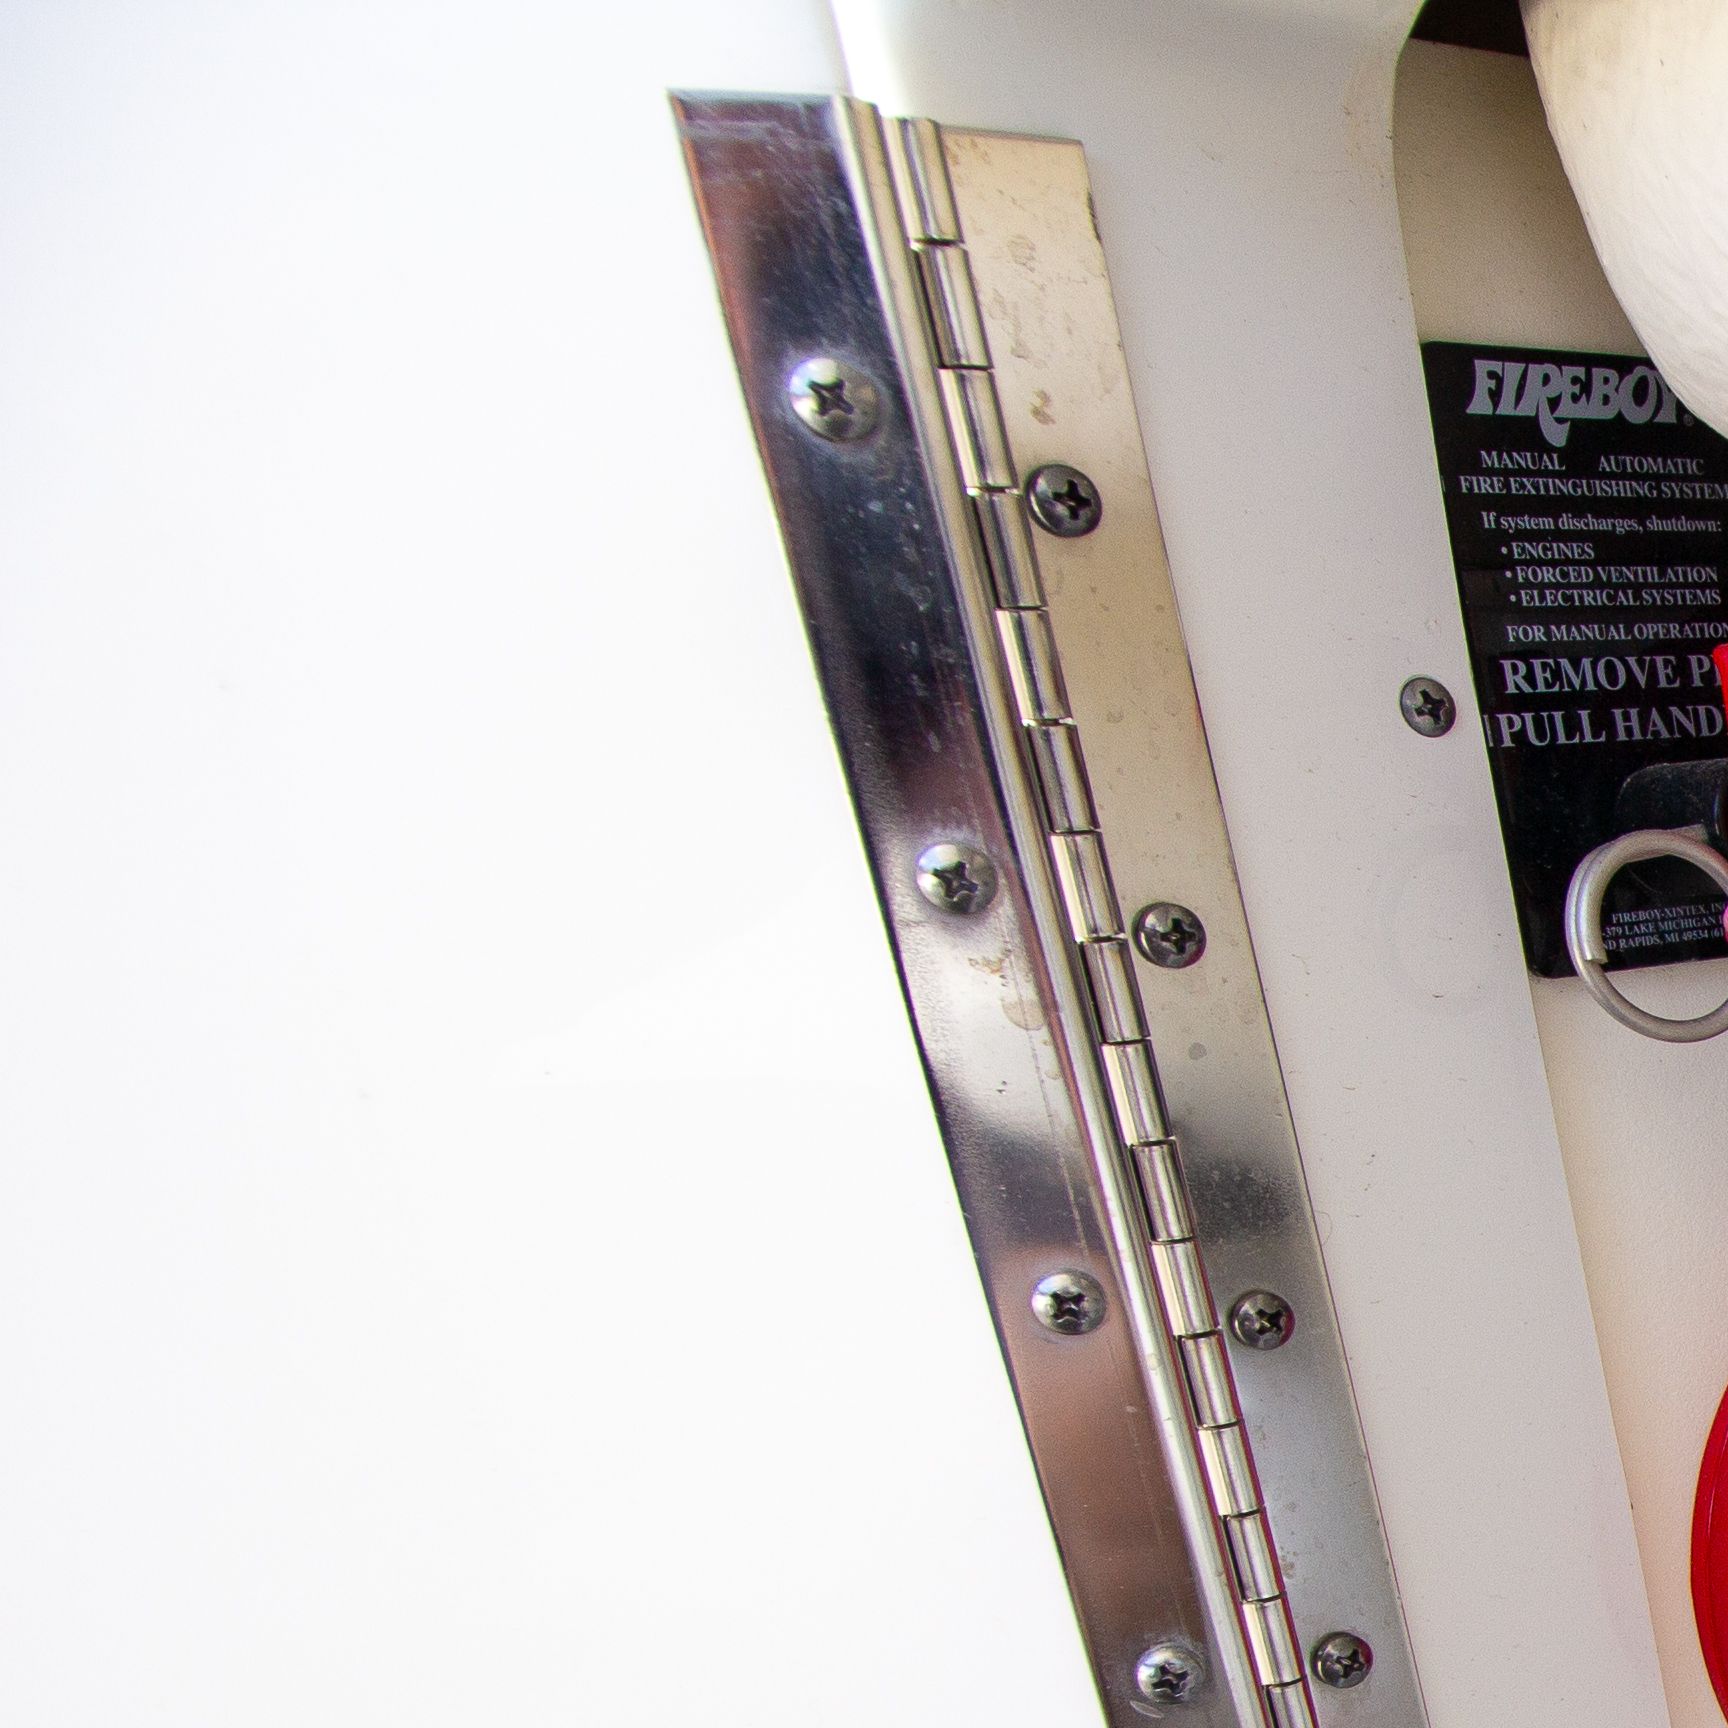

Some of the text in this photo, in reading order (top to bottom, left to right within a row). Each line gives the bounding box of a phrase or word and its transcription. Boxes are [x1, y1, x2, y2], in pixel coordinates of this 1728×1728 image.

[1466, 360, 1682, 447] FIREBOY
[1481, 451, 1704, 475] MANUAL AUTOMATIC
[1461, 475, 1506, 494] FIRE
[1512, 478, 1657, 499] EXTINGUISHING
[1481, 512, 1721, 534] If system discharges, shutdown:
[1512, 543, 1594, 559] ENGINES
[1517, 566, 1718, 583] FORCED VENTILATION
[1522, 589, 1721, 606] ELECTRICAL SYSTEMS
[1506, 625, 1548, 642] FOR
[1551, 624, 1631, 641] MANUAL
[1500, 655, 1680, 694] REMOVE
[1496, 705, 1728, 747] PULL HAND
[1625, 923, 1656, 936] LAKE
[1666, 933, 1679, 943] MI
